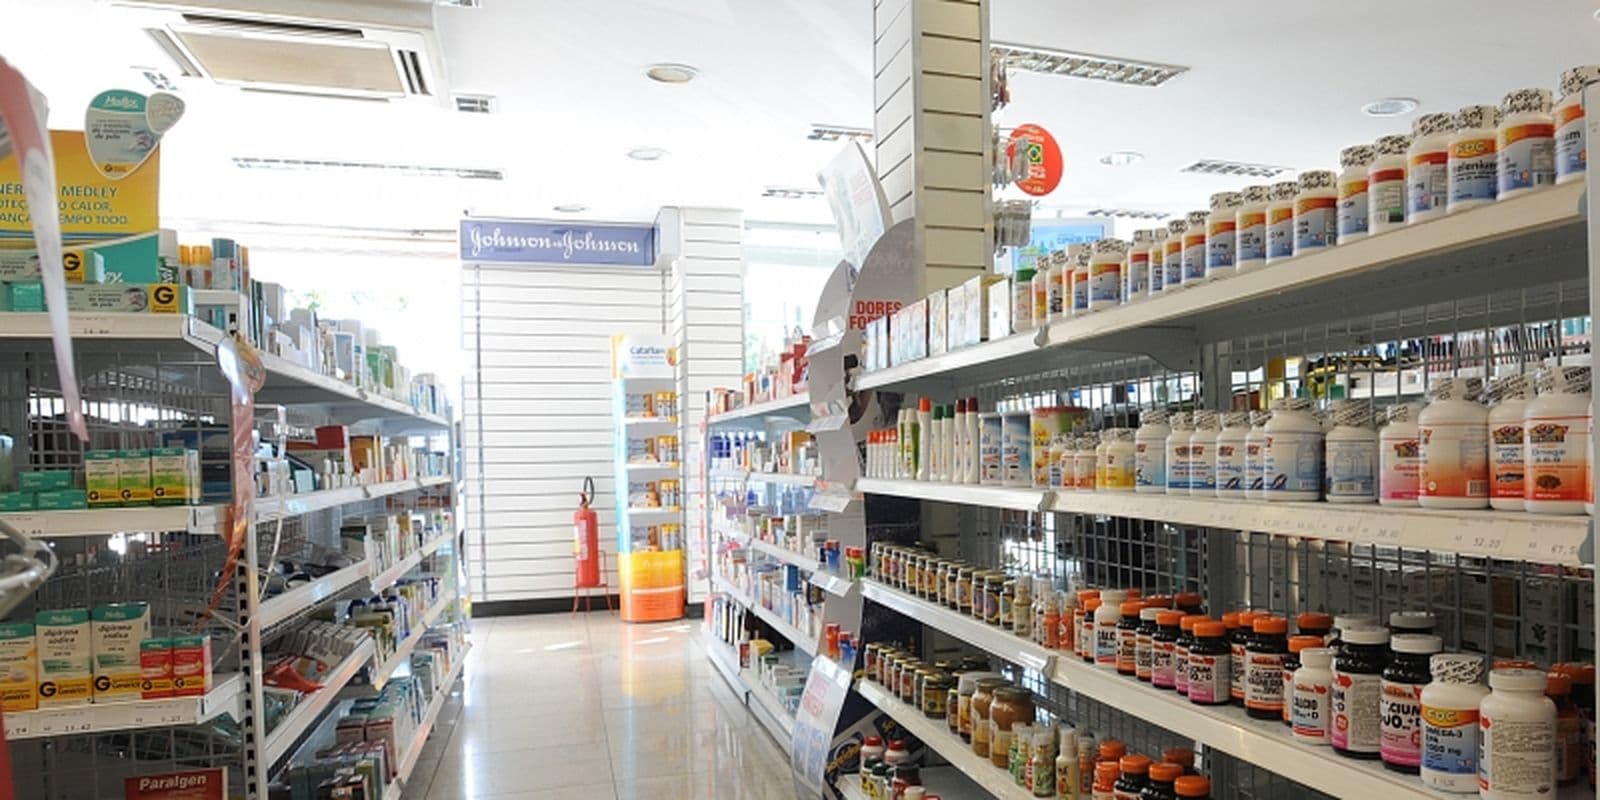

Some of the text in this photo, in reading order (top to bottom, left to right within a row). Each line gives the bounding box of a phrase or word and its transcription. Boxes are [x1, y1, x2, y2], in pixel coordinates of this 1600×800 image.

[61, 185, 118, 199] MEDLEY
[58, 214, 93, 225] EMPO
[471, 227, 552, 257] Johnson
[563, 229, 641, 260] Johnson
[856, 300, 903, 315] DORES
[39, 681, 57, 698] G
[95, 676, 111, 692] G
[139, 775, 208, 792] Paralgen
